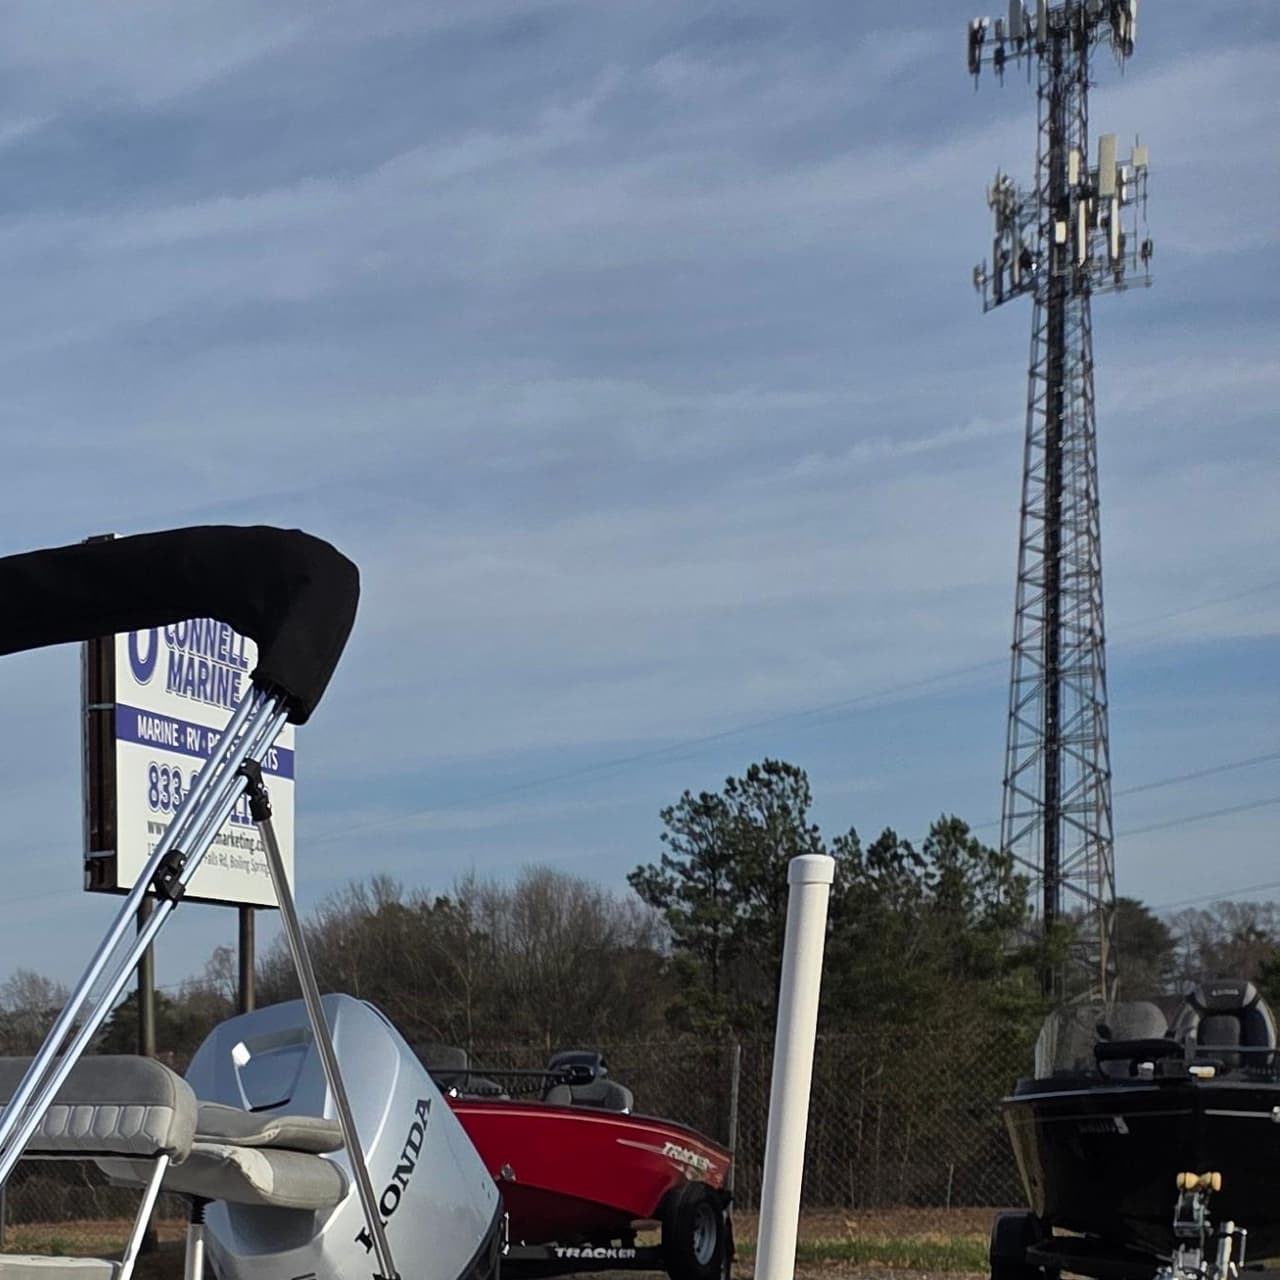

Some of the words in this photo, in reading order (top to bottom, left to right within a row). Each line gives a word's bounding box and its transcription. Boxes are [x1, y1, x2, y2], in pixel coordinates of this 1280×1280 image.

[166, 650, 242, 711] MARINE
[137, 714, 180, 747] MARINE
[186, 727, 202, 752] RV
[554, 1248, 636, 1259] TRACKER
